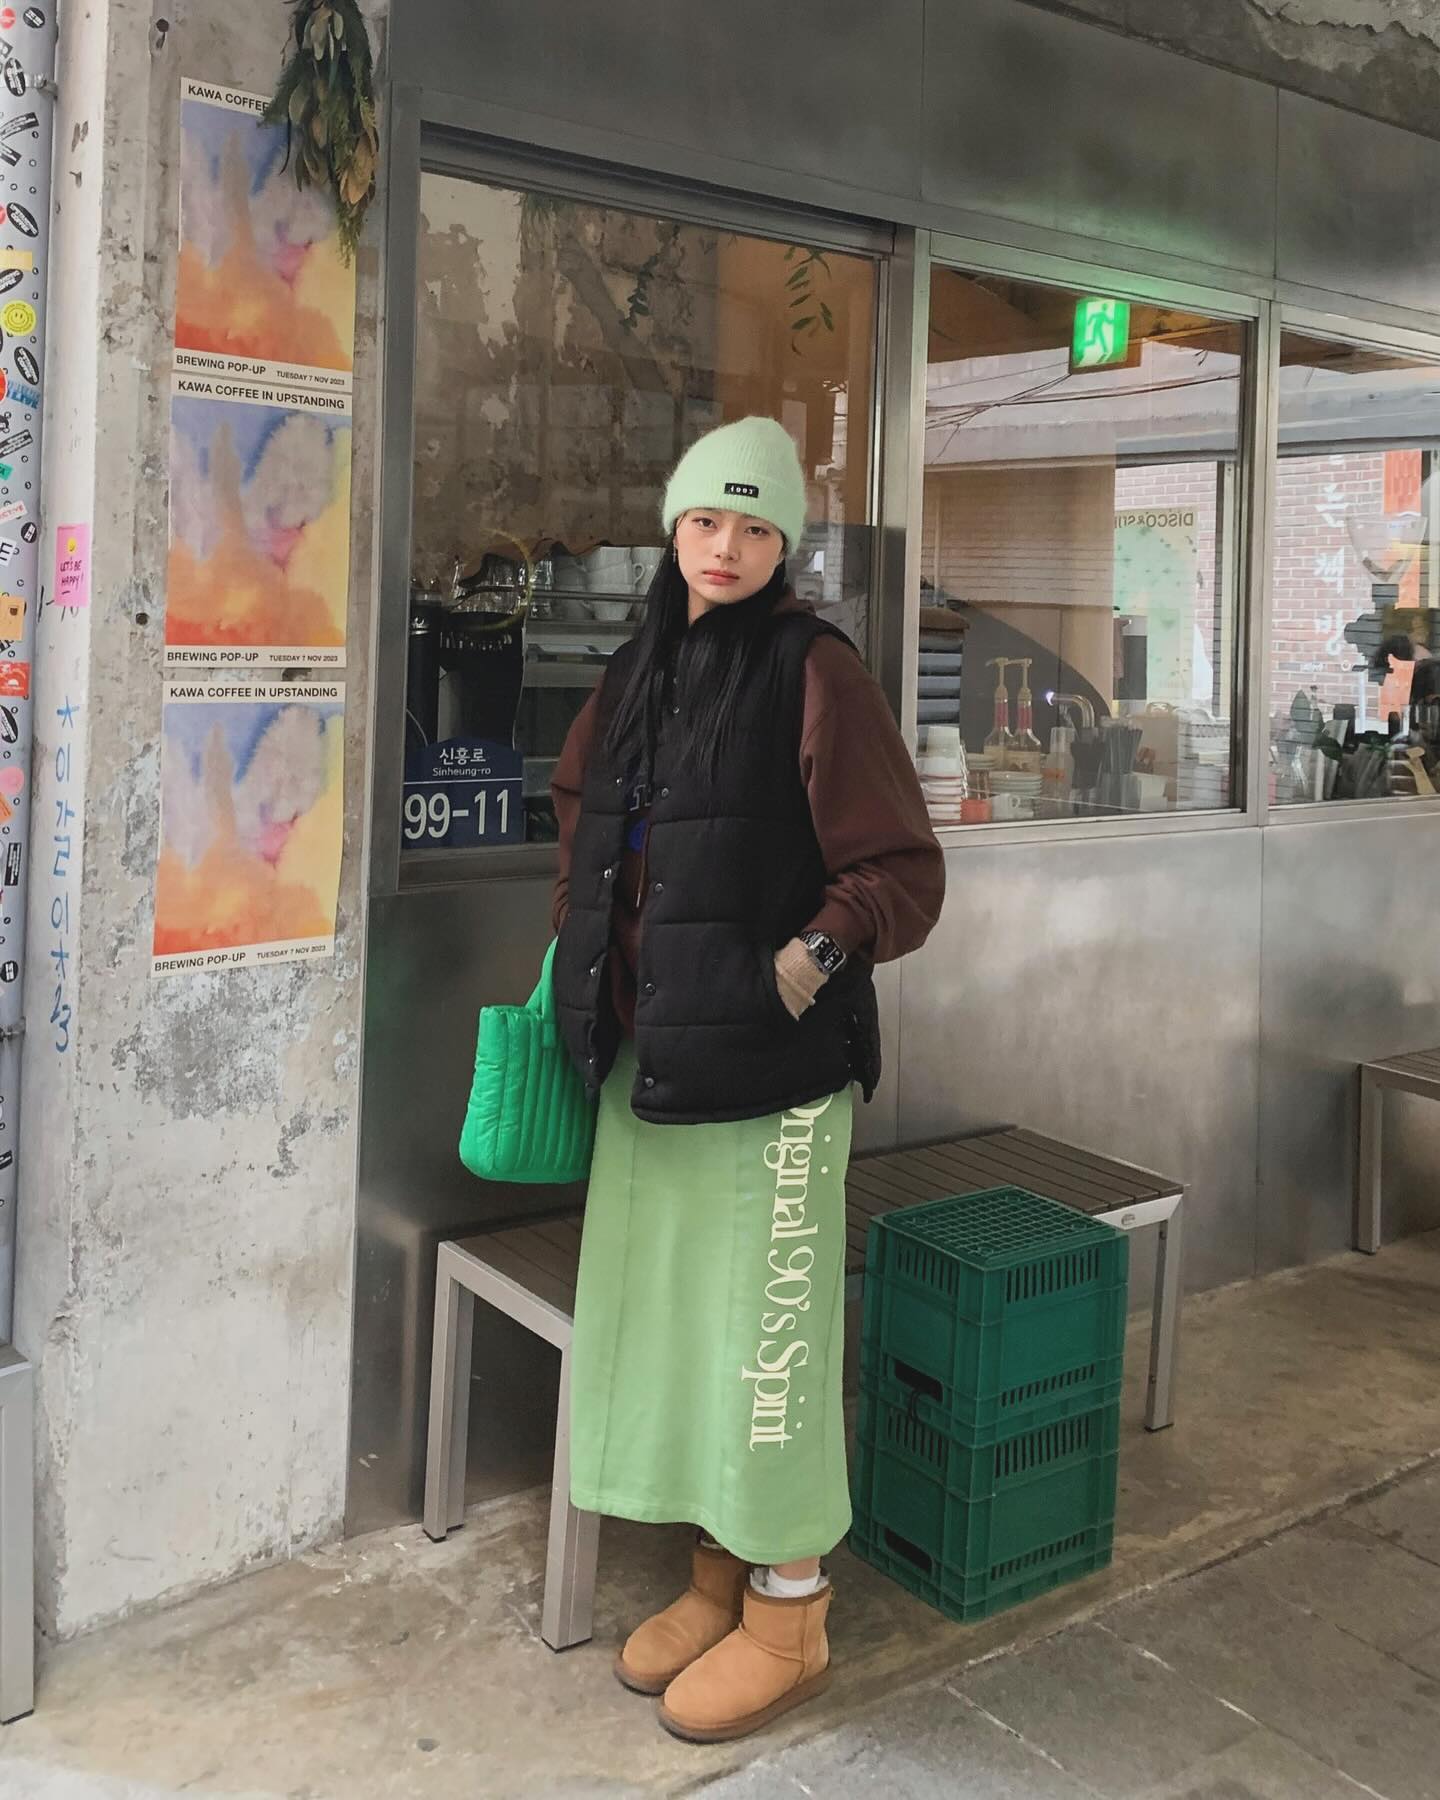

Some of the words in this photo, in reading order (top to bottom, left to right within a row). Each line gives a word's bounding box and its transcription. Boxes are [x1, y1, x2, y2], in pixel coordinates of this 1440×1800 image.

[187, 84, 222, 101] KAWA
[176, 354, 225, 370] BREWING
[227, 361, 266, 375] POP-UP
[276, 370, 308, 381] TUESDAY
[314, 376, 328, 384] NOV
[178, 380, 213, 394] KAWA
[215, 385, 259, 399] COFFEE
[262, 391, 273, 400] IN
[276, 392, 345, 409] UPSTANDING
[167, 652, 217, 662] BREWING
[220, 652, 259, 662] POP-UP
[170, 687, 204, 697] KAWA
[207, 687, 251, 697] COFFEE
[255, 687, 266, 697] IN
[269, 687, 338, 697] UPSTANDING
[439, 747, 487, 765] 신흥로
[432, 767, 492, 777] Sinheung-ro
[404, 789, 508, 839] 99-11
[154, 957, 204, 972] BREWING
[207, 952, 246, 966] POP-UP
[257, 950, 288, 959] TUESDAY
[741, 1339, 810, 1452] Spirit
